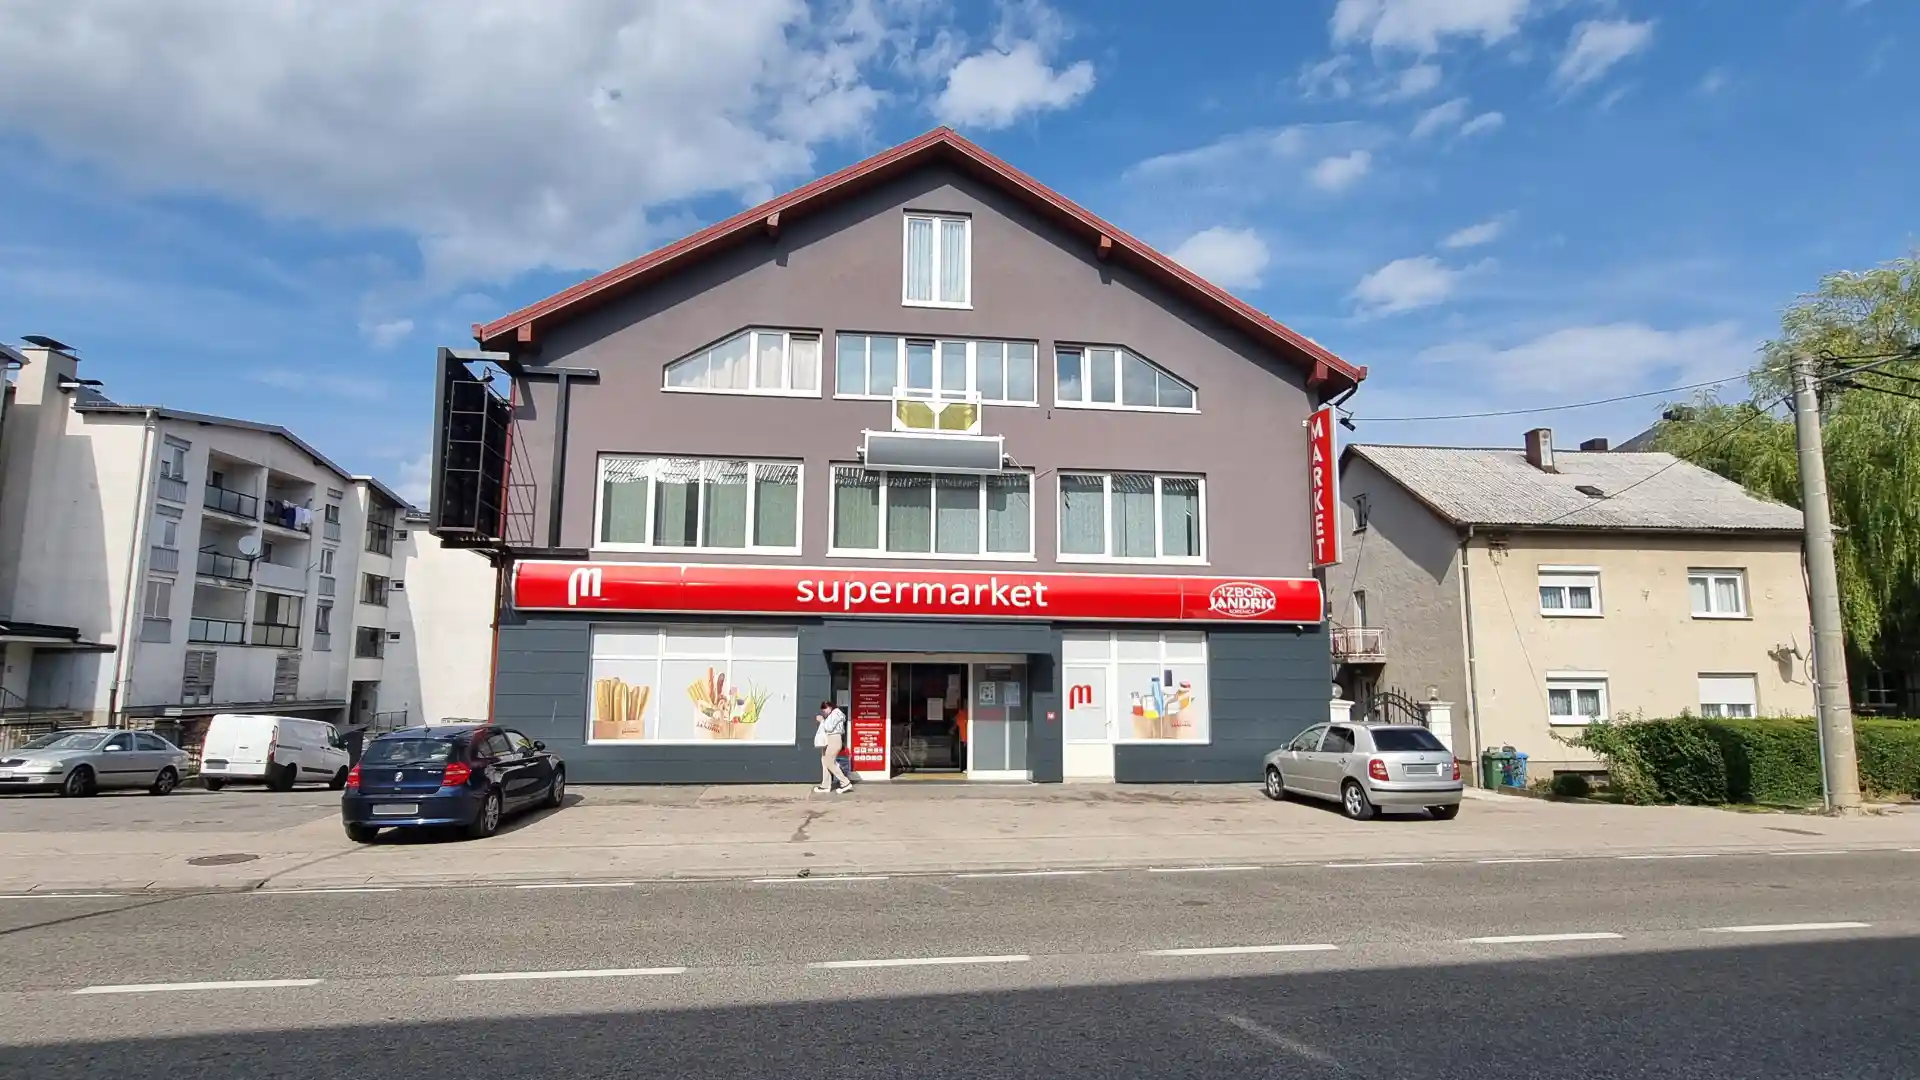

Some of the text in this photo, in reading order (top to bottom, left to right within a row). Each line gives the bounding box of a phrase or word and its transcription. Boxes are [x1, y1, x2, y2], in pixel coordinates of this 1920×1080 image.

[1311, 416, 1325, 560] MARKET
[797, 577, 1048, 610] supermarket
[1222, 587, 1263, 597] IZBOR
